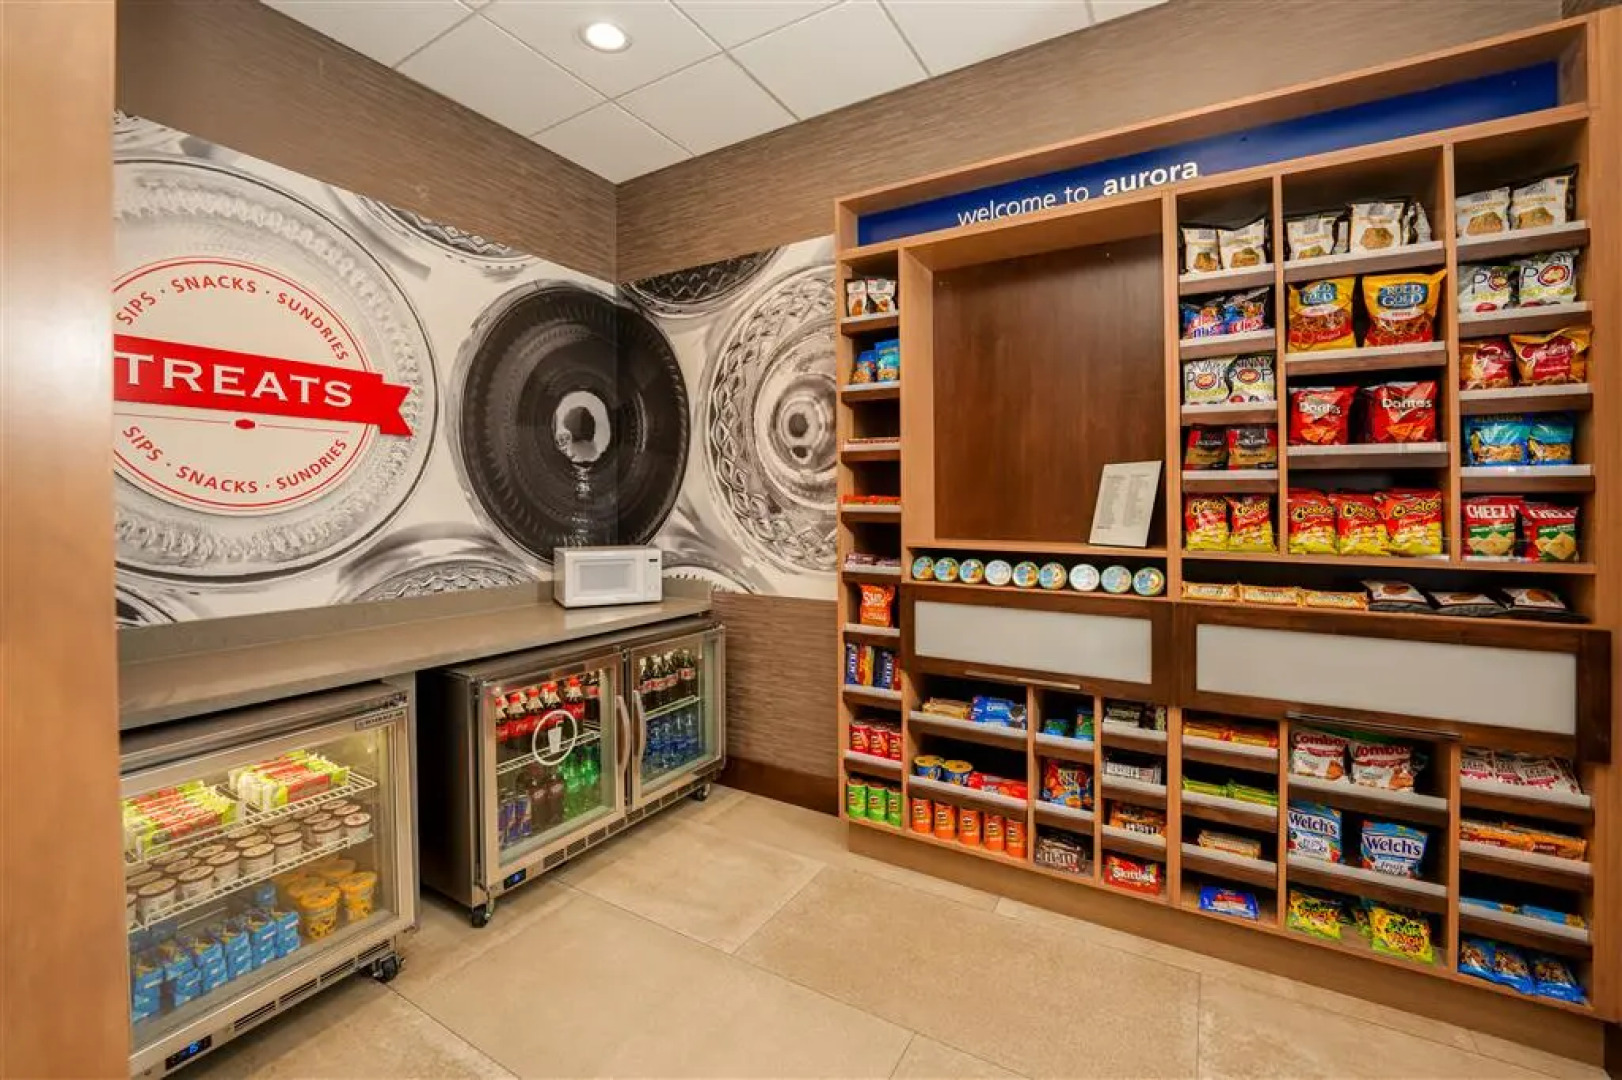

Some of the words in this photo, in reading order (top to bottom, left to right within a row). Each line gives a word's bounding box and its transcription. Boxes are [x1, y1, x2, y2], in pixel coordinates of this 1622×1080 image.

[957, 193, 1056, 226] welcome
[1064, 186, 1089, 205] to
[1103, 160, 1199, 196] aurora
[116, 290, 157, 325] SIPS
[170, 274, 257, 294] SNACKS
[276, 291, 350, 361] SUNDRIES
[114, 351, 353, 408] TREATS
[1382, 396, 1433, 410] Doritos
[122, 425, 164, 462] SIPS
[175, 465, 259, 494] SNACKS
[275, 438, 348, 491] SUNDRIES
[1288, 811, 1338, 836] Welch's
[1364, 834, 1423, 857] Welch's
